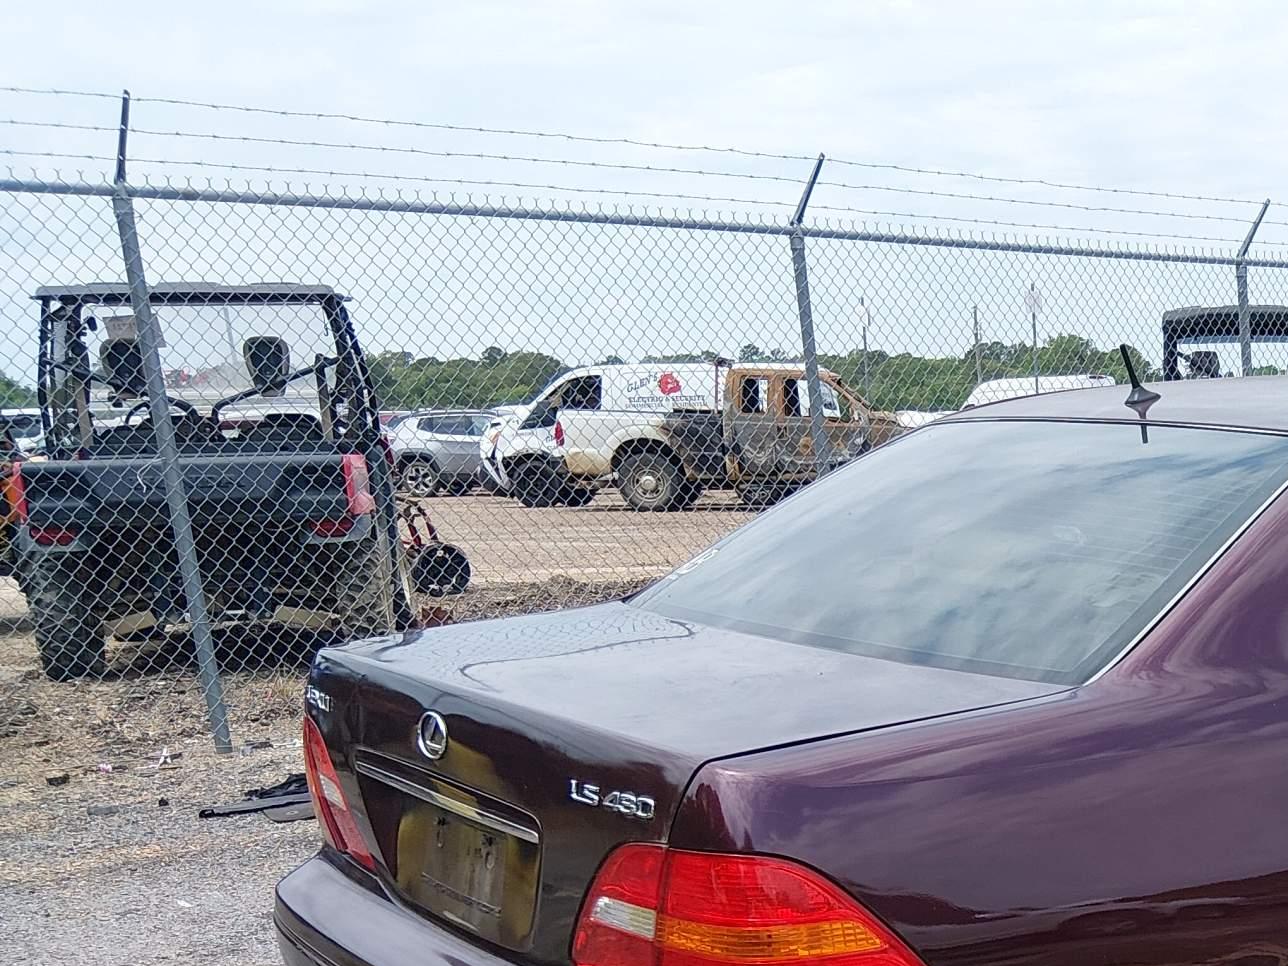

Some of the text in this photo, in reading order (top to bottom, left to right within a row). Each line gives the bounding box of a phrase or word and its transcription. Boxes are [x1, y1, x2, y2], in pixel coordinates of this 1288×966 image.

[626, 372, 658, 392] GLEN'S
[570, 778, 655, 818] LS 430
